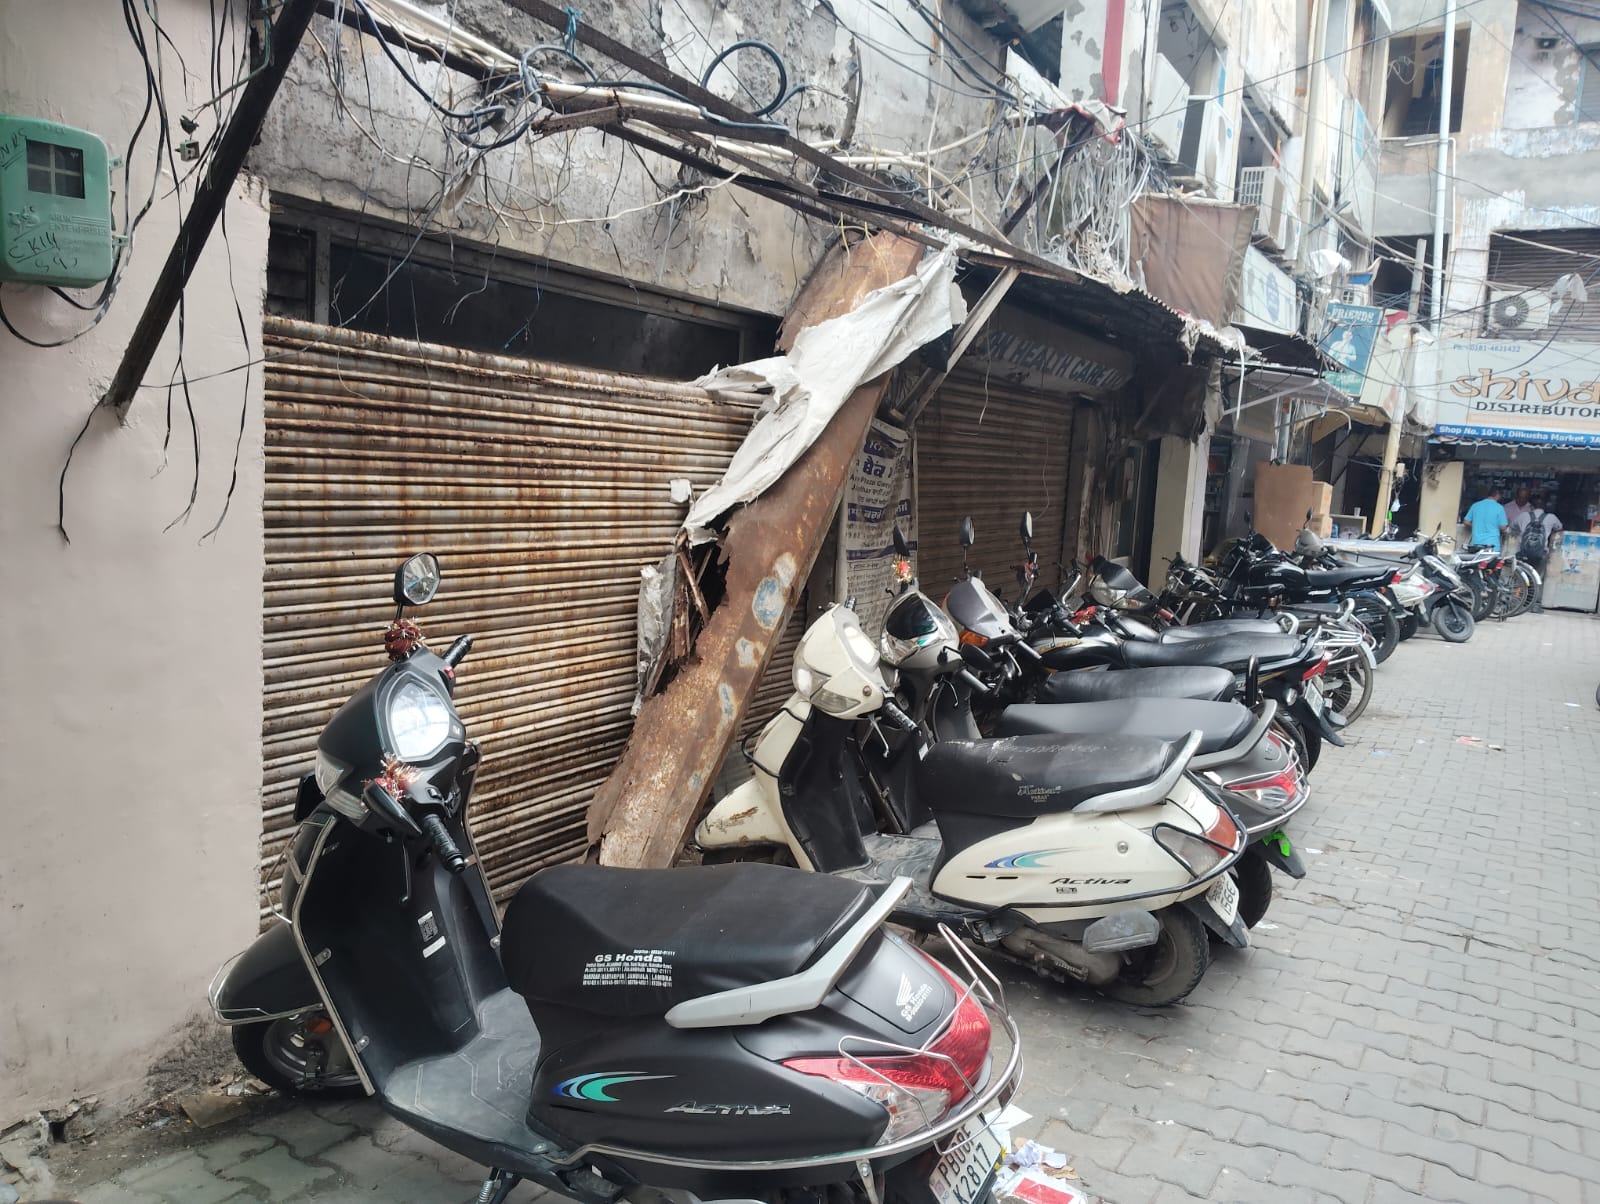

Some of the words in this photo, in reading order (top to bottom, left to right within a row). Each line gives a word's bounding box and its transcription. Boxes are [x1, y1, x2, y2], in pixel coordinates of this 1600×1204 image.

[1331, 307, 1375, 323] FRIENDS
[1070, 357, 1107, 386] CARE
[1439, 423, 1461, 435] Shop
[1463, 426, 1479, 435] No.
[1508, 429, 1549, 441] Dilkusha
[1550, 432, 1587, 443] Market,
[1049, 877, 1133, 885] Activa
[594, 954, 612, 963] GS
[615, 953, 663, 963] Honda
[952, 1142, 992, 1204] K2817
